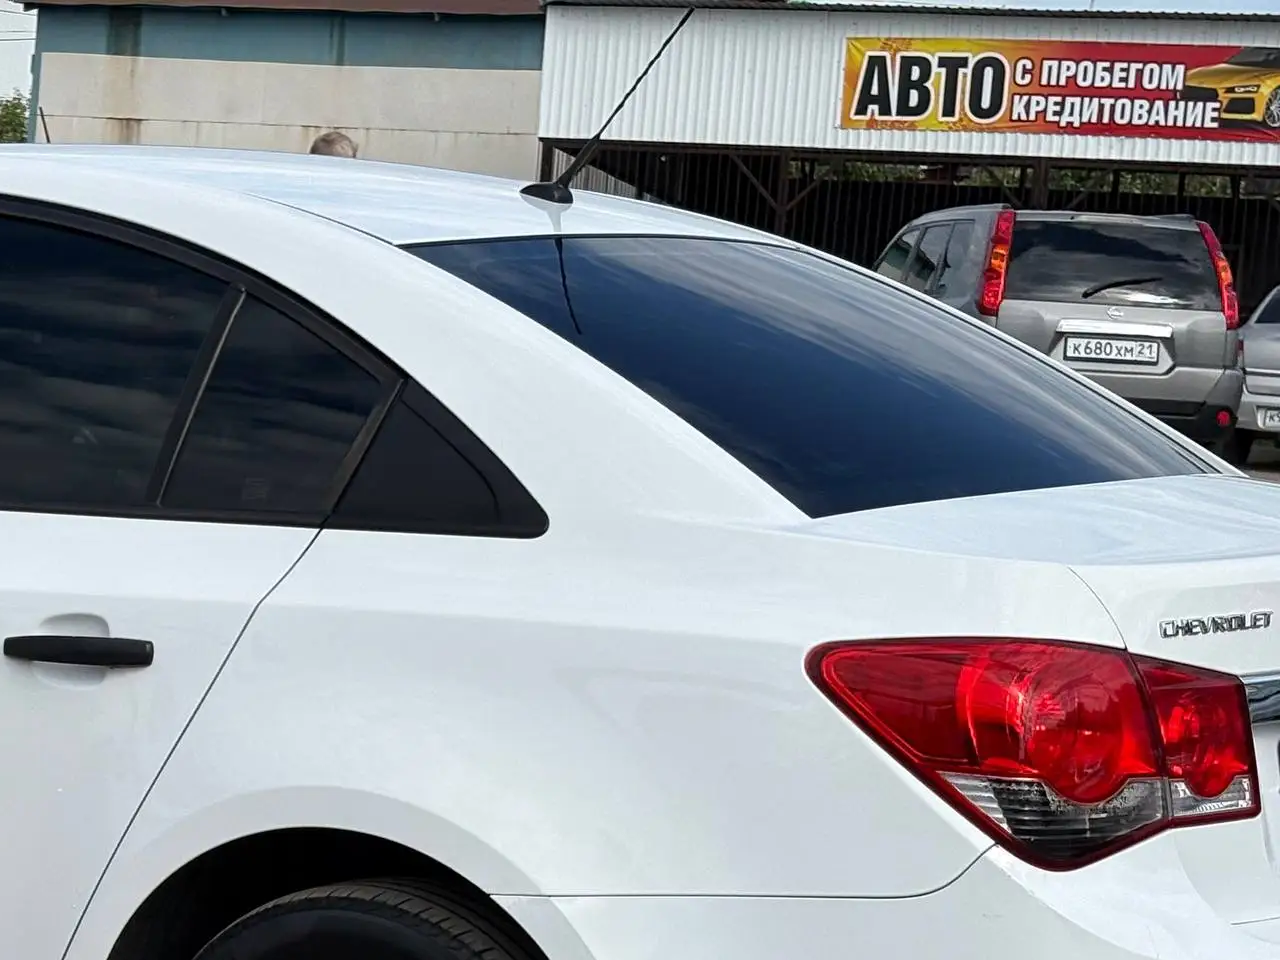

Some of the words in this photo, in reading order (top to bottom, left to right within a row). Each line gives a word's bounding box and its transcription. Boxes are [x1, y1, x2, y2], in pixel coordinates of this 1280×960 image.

[852, 52, 1008, 122] АВТО
[1014, 58, 1033, 86] С
[1040, 59, 1186, 90] ПРОБЕГОМ
[1011, 94, 1220, 128] КРЕДИТОВАНИЕ
[1159, 609, 1274, 638] CHEVROLET
